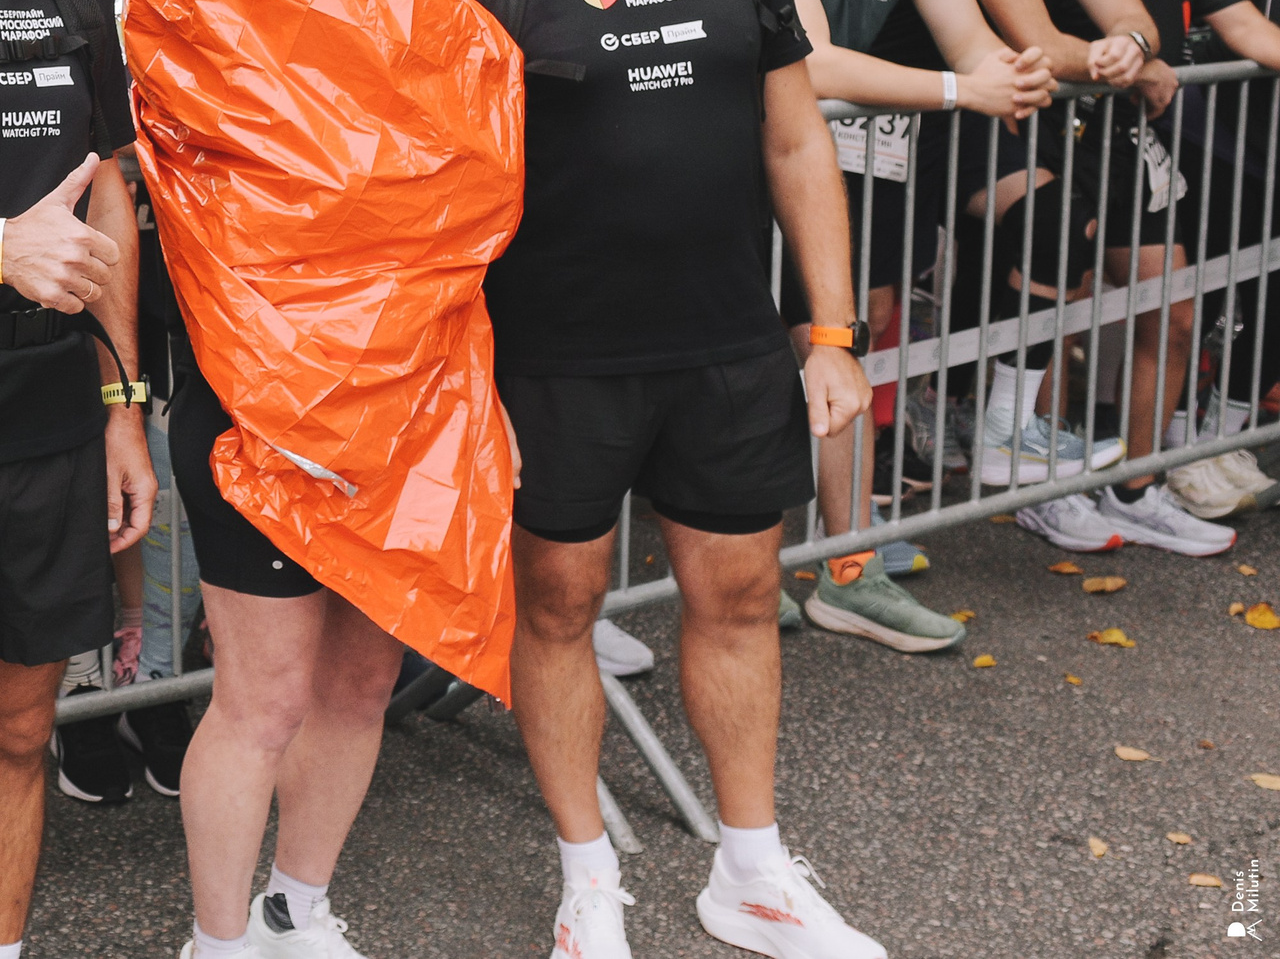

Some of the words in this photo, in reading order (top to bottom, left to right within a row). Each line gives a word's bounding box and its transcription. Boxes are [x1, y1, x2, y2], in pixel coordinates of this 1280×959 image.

[0, 15, 64, 30] МОСКОВСКИЙ
[621, 30, 661, 47] СБЕР
[39, 71, 66, 81] Прайм
[627, 61, 693, 82] HUAWEI
[630, 79, 660, 92] WATCH
[661, 78, 672, 89] GT
[674, 77, 680, 87] 7
[680, 76, 694, 87] Pro
[1, 110, 61, 126] HUAWEI
[2, 128, 29, 138] WATCH
[30, 128, 41, 137] GT
[42, 127, 47, 136] 7
[48, 127, 61, 136] Pro
